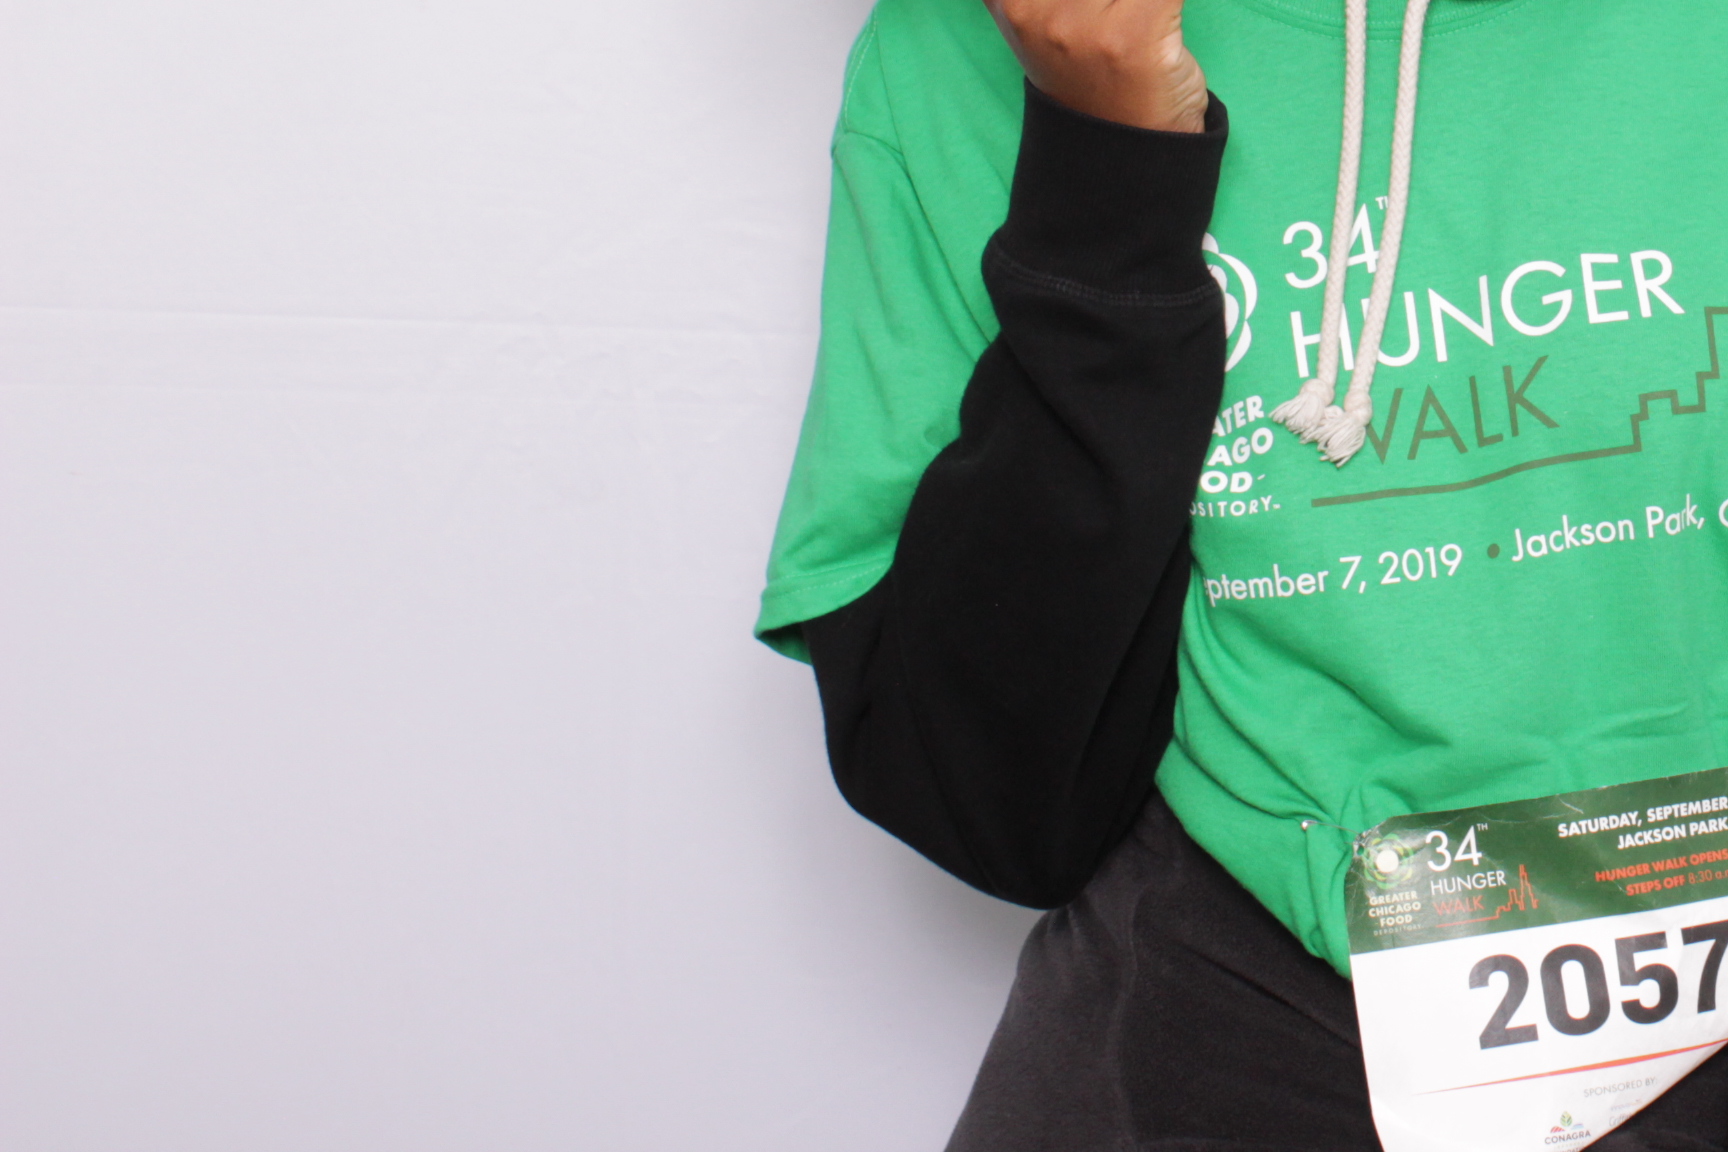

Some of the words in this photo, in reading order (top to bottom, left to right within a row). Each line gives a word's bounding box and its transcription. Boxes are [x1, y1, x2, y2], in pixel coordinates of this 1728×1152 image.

[1289, 249, 1685, 379] HUNGER
[1212, 395, 1265, 437] ATER
[1200, 470, 1253, 493] OD
[1203, 563, 1329, 608] ptember
[1338, 555, 1367, 594] 7,
[1378, 543, 1463, 586] 2019
[1511, 514, 1635, 562] Jackson
[1645, 493, 1705, 538] Park,
[1557, 811, 1642, 838] SATURDAY,
[1646, 796, 1728, 823] SEPTEMBER
[1617, 824, 1687, 849] JACKSON
[1595, 862, 1652, 882] HUNGER
[1652, 856, 1688, 873] WALK
[1430, 870, 1507, 896] HUNGER
[1626, 878, 1662, 896] STEPS
[1664, 874, 1686, 889] OFF
[1688, 868, 1713, 884] 8:30
[1368, 901, 1422, 919] CHICAGO
[1369, 890, 1418, 906] GREATER
[1432, 895, 1485, 916] WALK
[1379, 914, 1413, 928] FOOD
[1583, 1079, 1643, 1098] SPONSORED
[1544, 1130, 1591, 1145] CONAGRA
